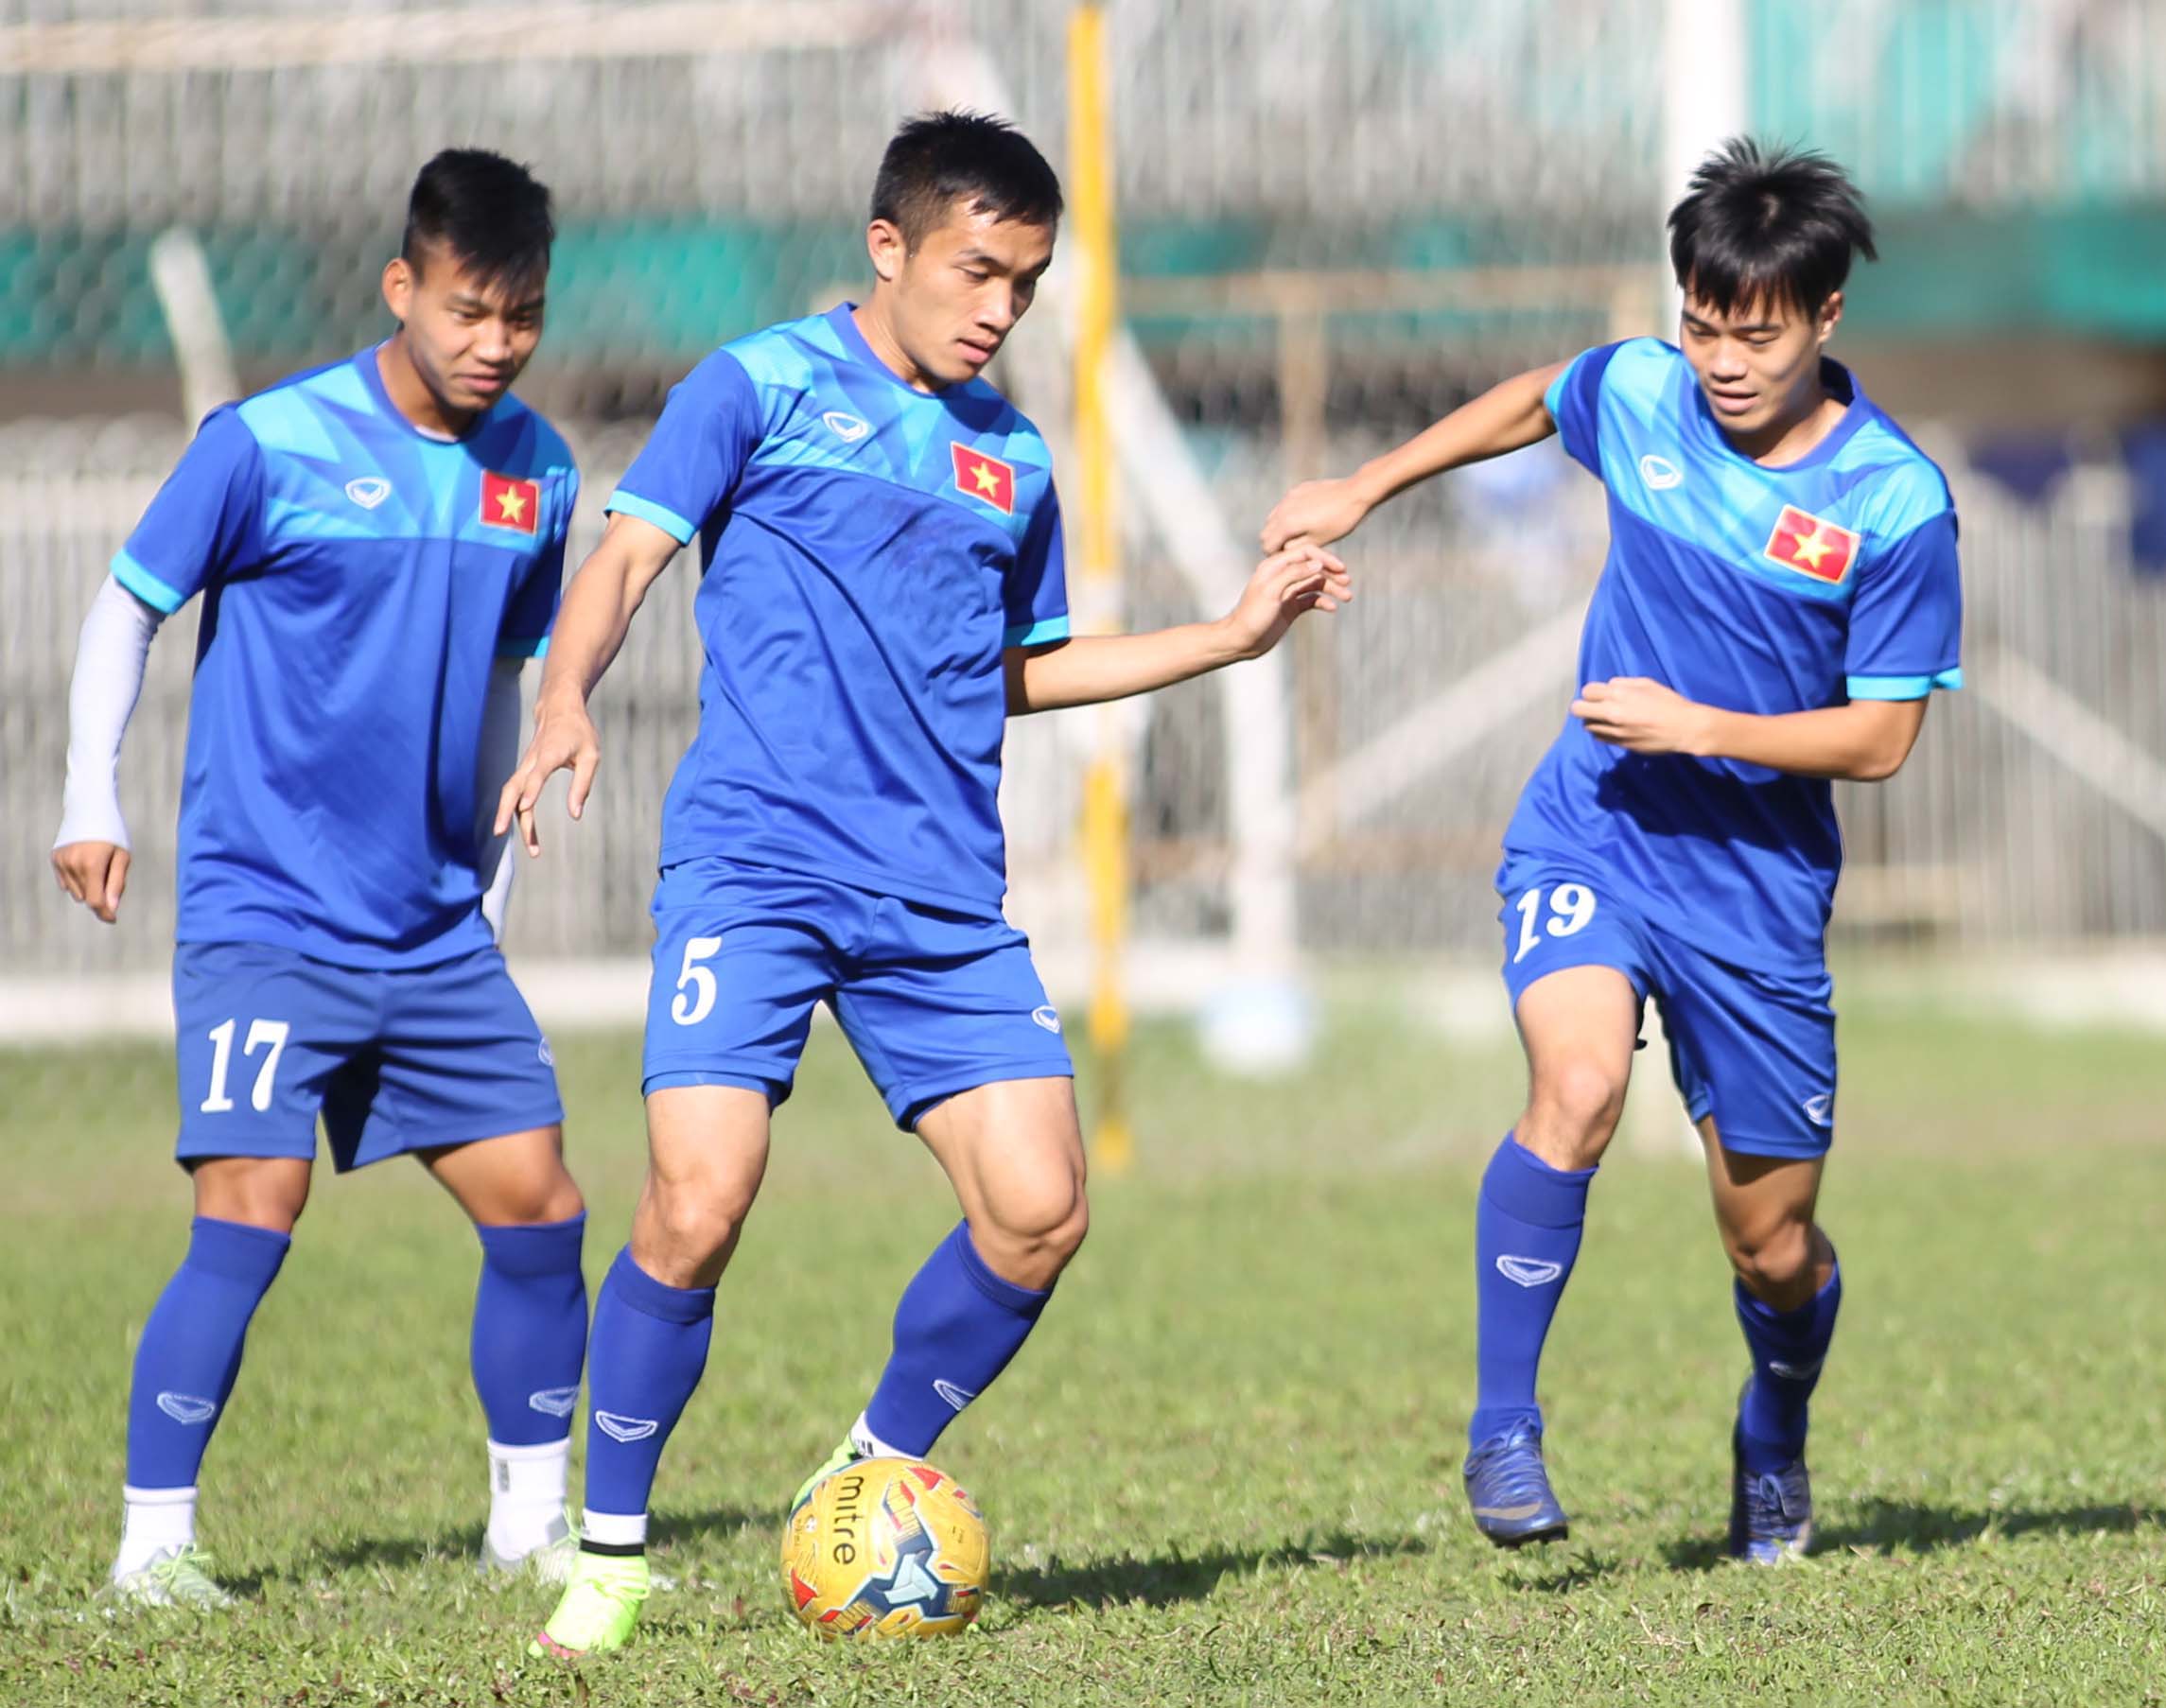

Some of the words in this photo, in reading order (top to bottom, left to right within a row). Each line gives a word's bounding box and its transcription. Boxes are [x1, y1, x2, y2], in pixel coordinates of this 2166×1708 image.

[1513, 882, 1598, 965] 19
[672, 936, 723, 1026] 5
[201, 1018, 289, 1113] 17
[833, 1475, 865, 1565] mitre
